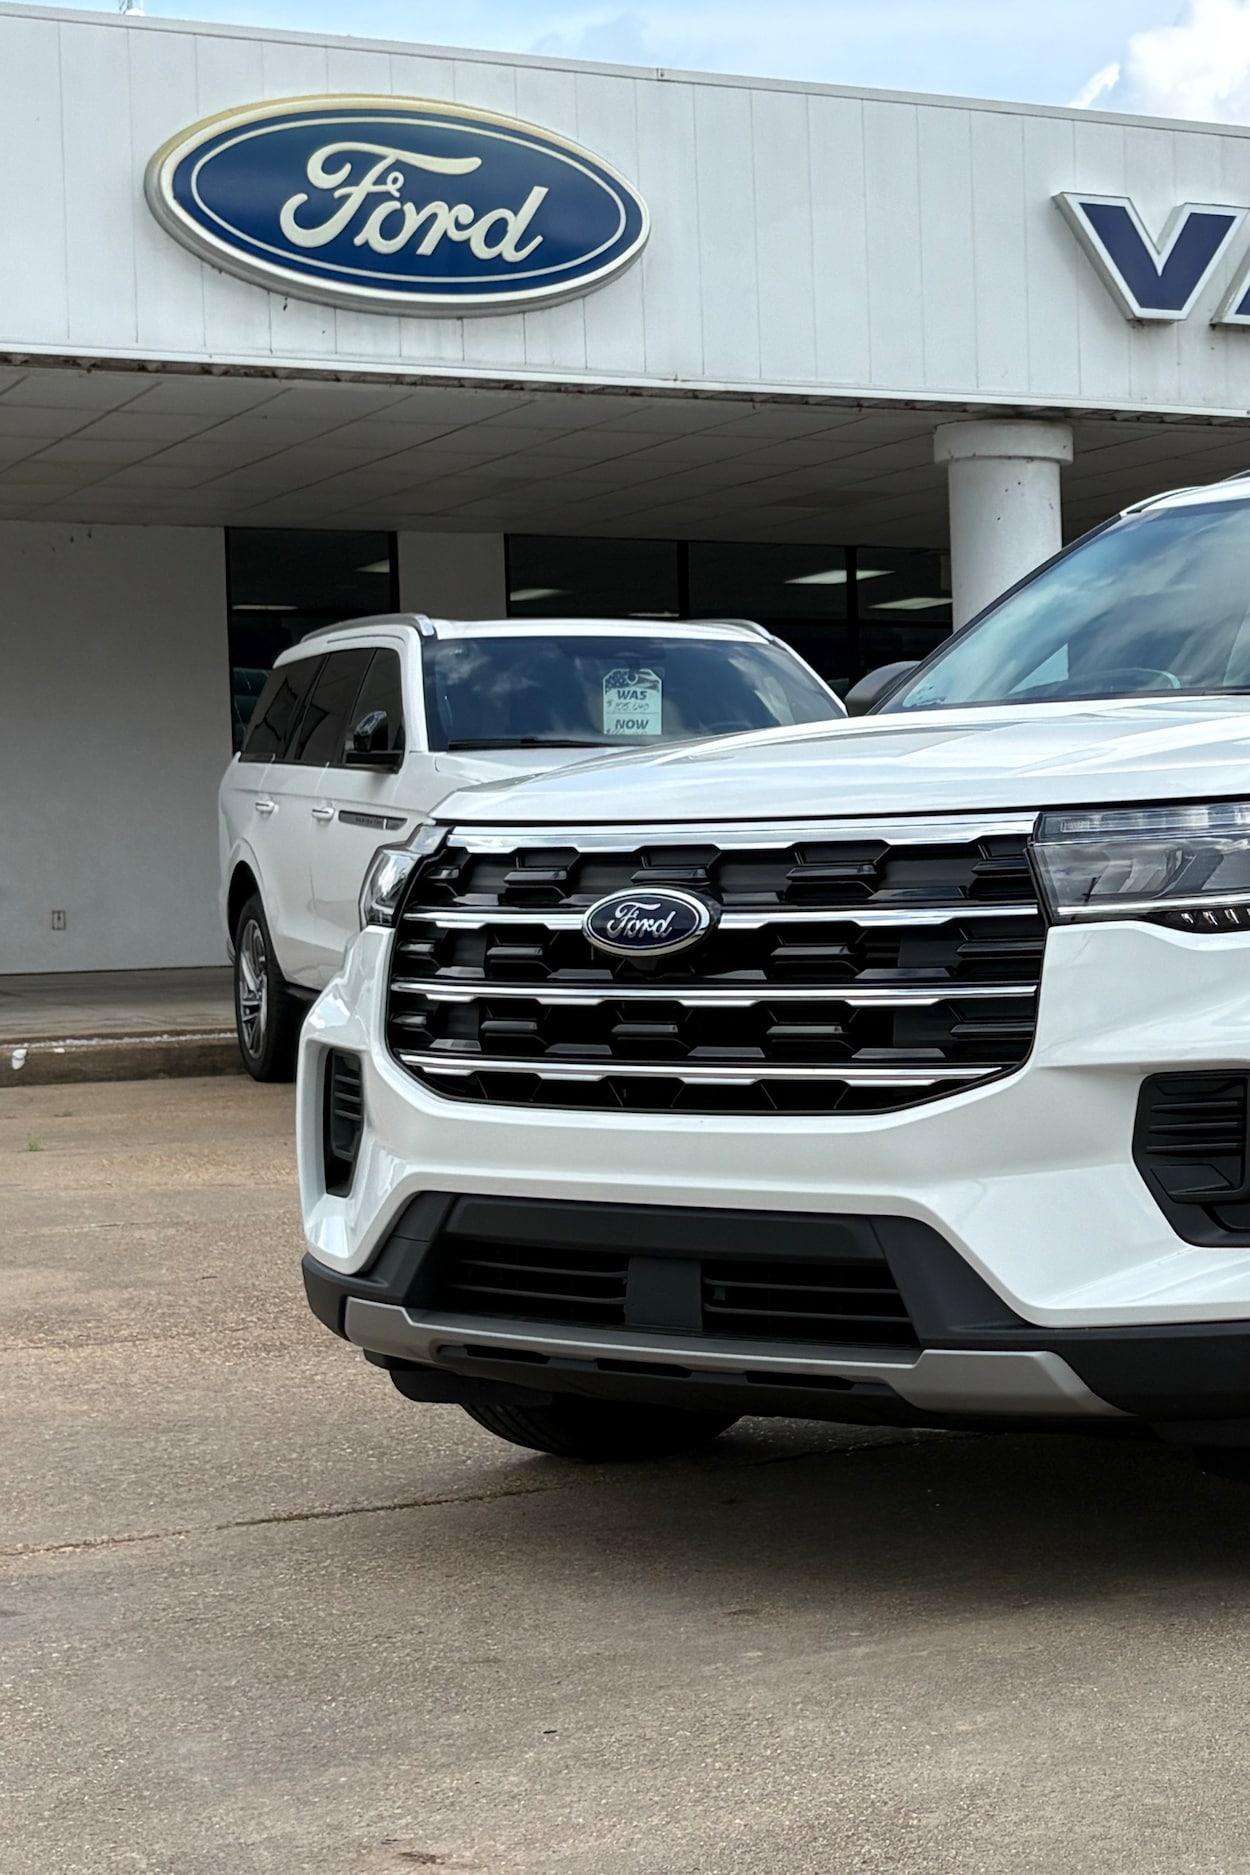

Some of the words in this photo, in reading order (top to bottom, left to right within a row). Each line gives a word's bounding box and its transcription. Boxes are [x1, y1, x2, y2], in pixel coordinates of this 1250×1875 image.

[280, 142, 549, 263] Ford
[617, 689, 648, 700] WAS
[615, 718, 650, 730] NOW
[606, 901, 677, 939] Ford
